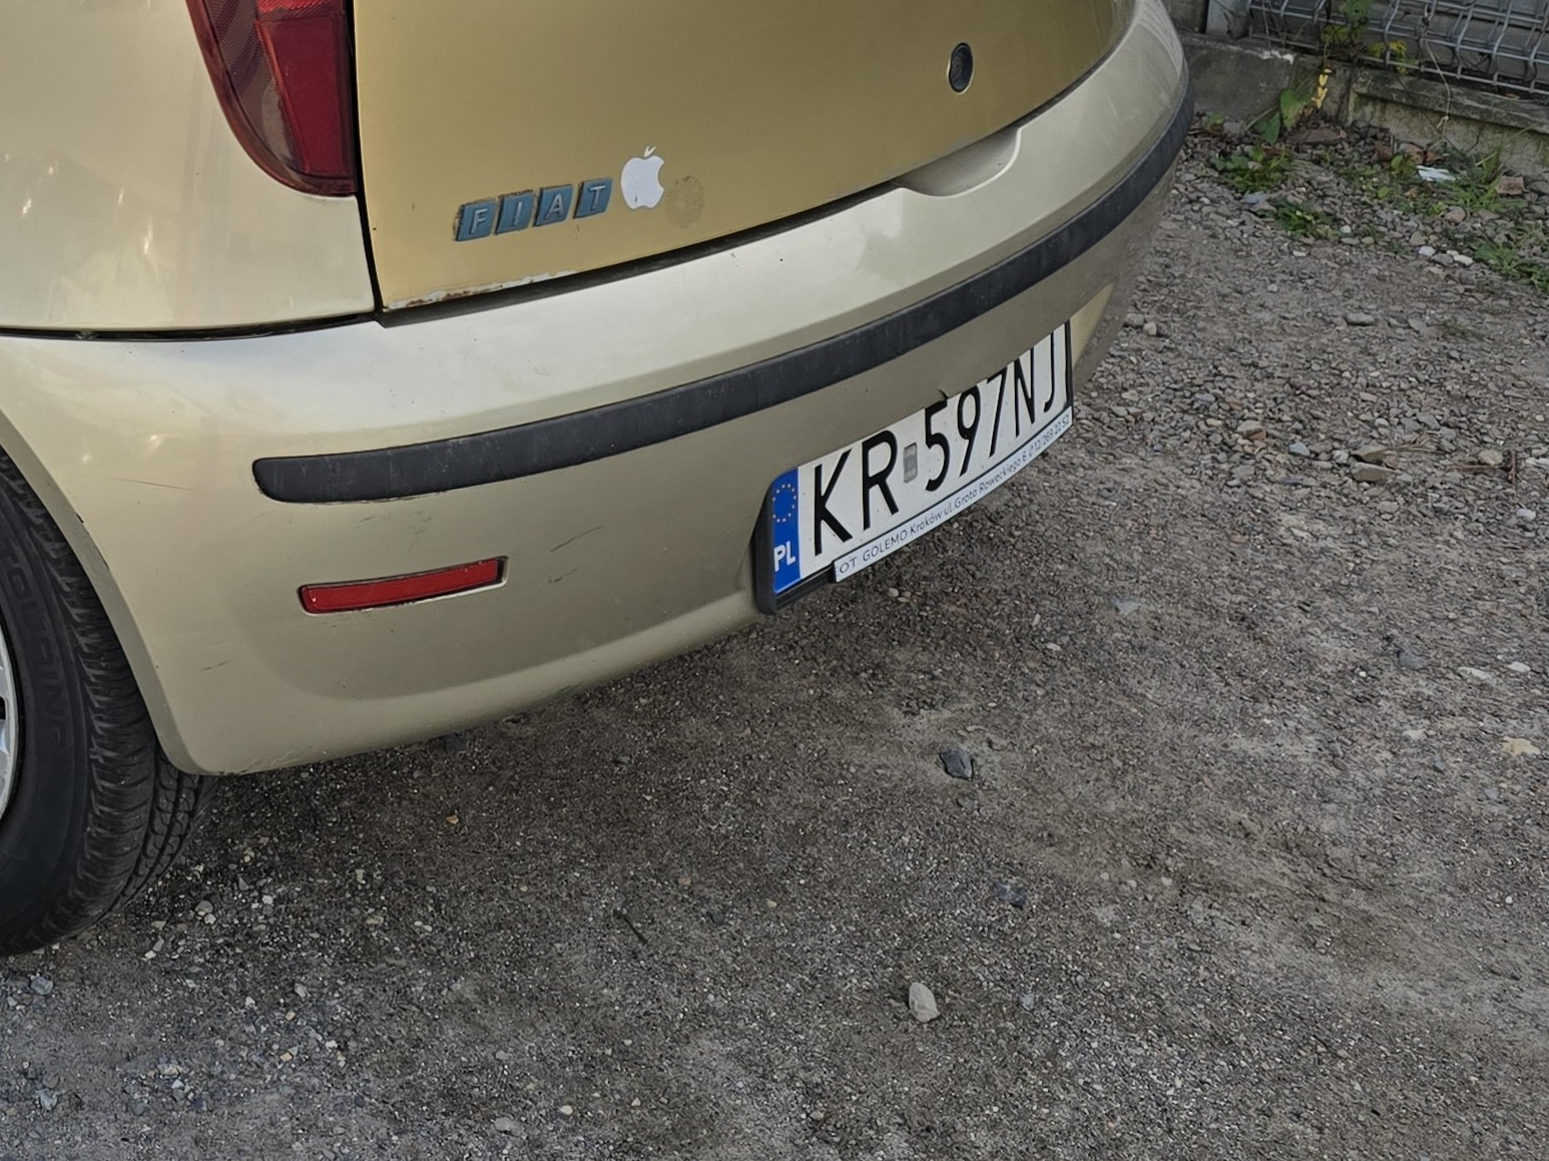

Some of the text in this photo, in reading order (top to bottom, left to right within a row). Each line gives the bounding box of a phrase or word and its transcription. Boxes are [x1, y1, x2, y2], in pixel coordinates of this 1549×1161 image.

[464, 182, 609, 238] FIAT
[813, 332, 1054, 556] KR 597NJ
[773, 540, 797, 572] PL
[862, 530, 908, 562] GOLEMO
